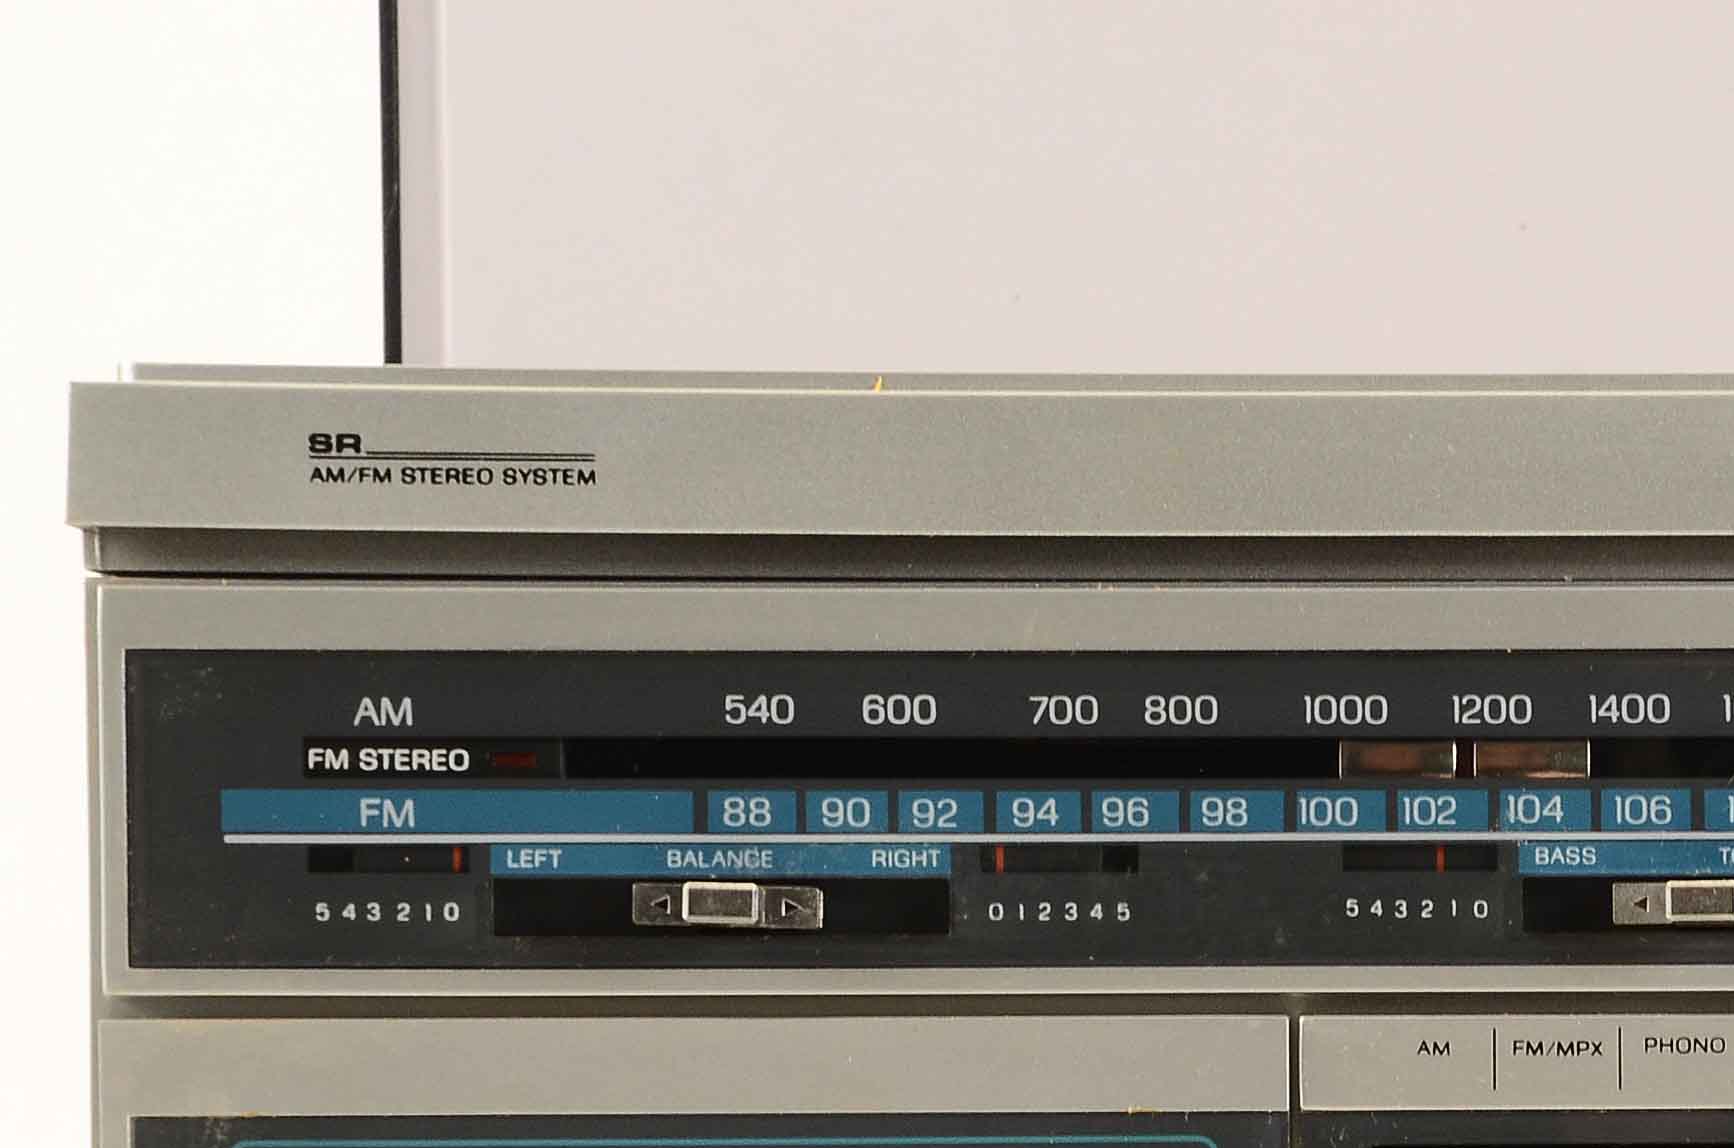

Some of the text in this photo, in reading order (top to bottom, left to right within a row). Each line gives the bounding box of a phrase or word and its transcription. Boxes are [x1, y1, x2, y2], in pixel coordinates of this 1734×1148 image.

[307, 432, 363, 455] SR
[310, 466, 596, 486] AM/FM STEREO SYSTEM
[353, 696, 413, 727] AM
[725, 694, 795, 725] 540
[862, 694, 937, 725] 600
[1029, 694, 1099, 725] 700
[1144, 694, 1218, 726] 800
[1303, 694, 1388, 725] 1000
[1452, 694, 1532, 725] 1200
[1589, 693, 1671, 724] 1400
[307, 747, 470, 772] FM STEREO
[359, 797, 415, 828] FM
[723, 796, 772, 827] 88
[821, 797, 871, 828] 90
[911, 798, 958, 829] 92
[1012, 797, 1059, 828] 94
[1101, 796, 1149, 828] 96
[1201, 797, 1248, 827] 98
[1299, 796, 1359, 827] 100
[1403, 795, 1457, 826] 102
[1507, 794, 1564, 824] 104
[1615, 795, 1672, 825] 106
[506, 848, 563, 869] LEFT
[666, 847, 773, 869] BALANCE
[871, 849, 941, 868] RIGHT
[1535, 846, 1597, 866] BASS
[1417, 1040, 1452, 1056] AM
[1512, 1039, 1603, 1057] FM/MPX
[1644, 1036, 1726, 1055] PHONO
